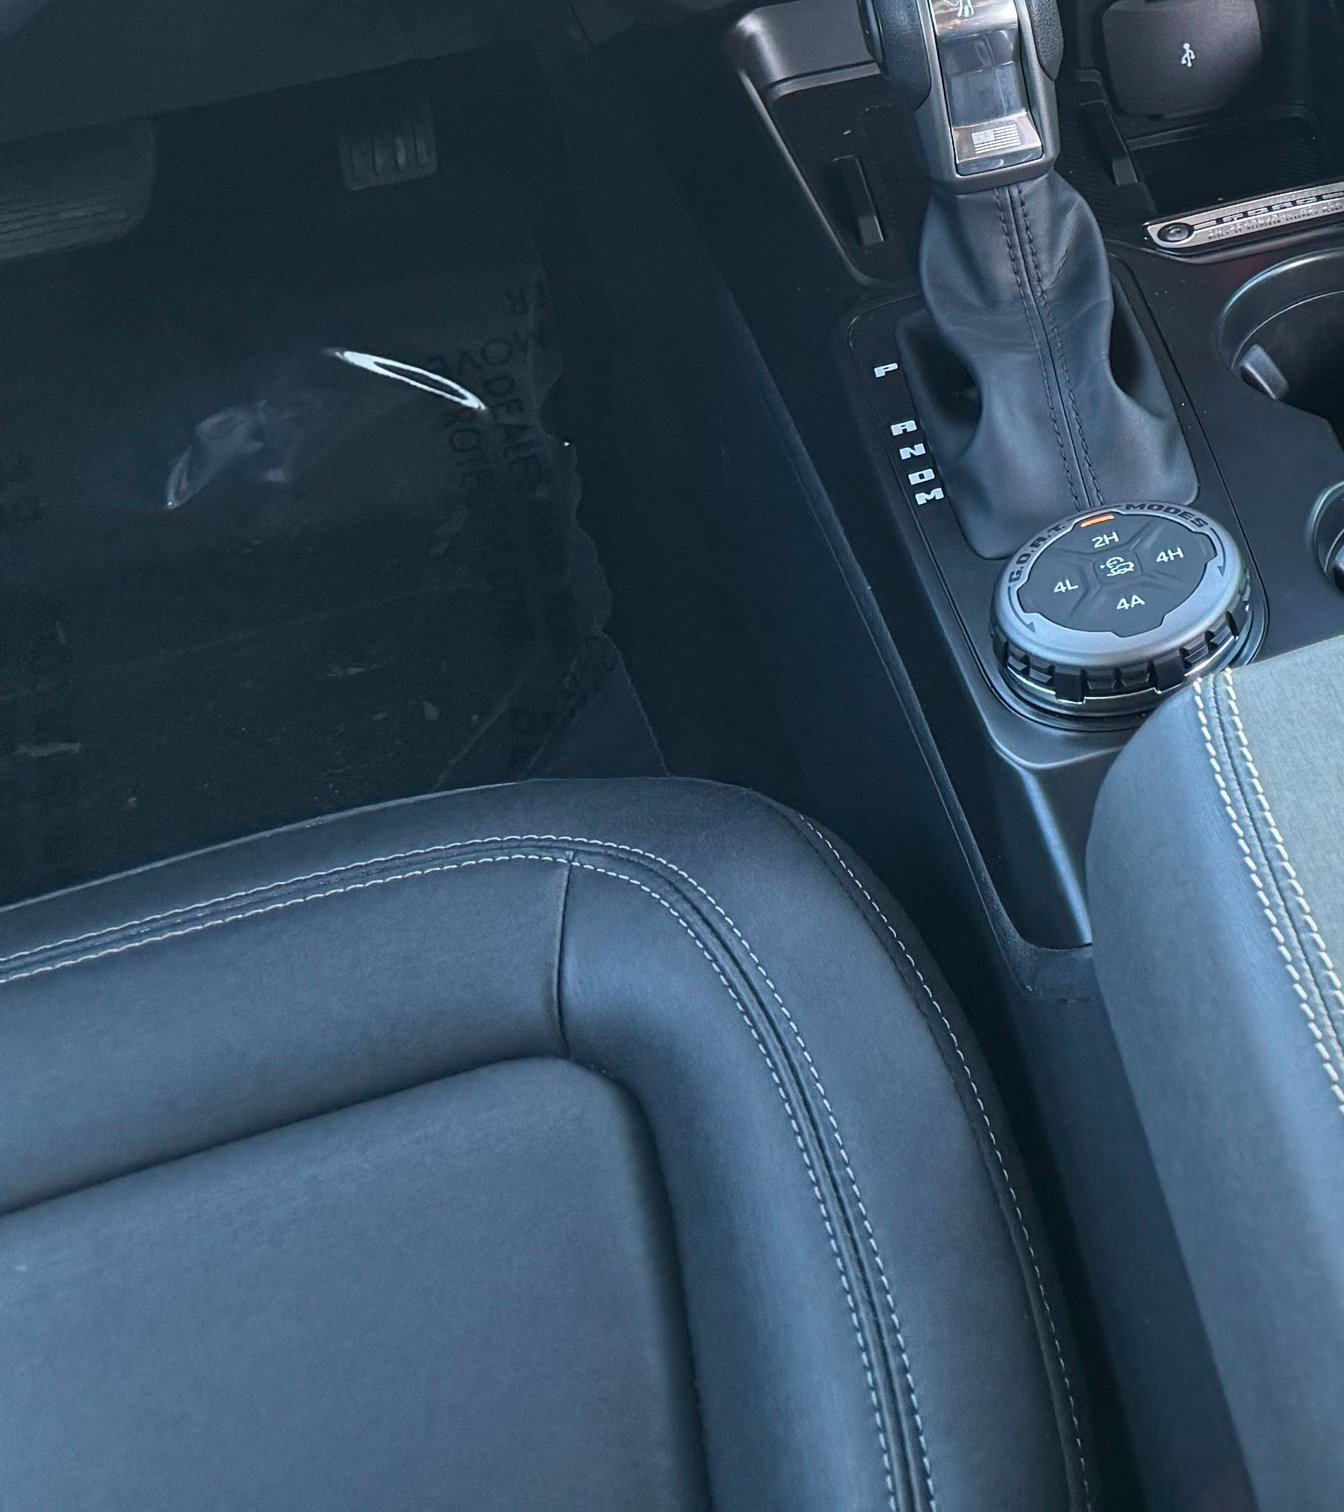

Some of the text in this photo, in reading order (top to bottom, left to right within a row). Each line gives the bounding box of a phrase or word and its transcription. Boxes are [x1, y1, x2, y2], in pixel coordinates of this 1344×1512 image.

[874, 363, 898, 378] P
[890, 420, 917, 436] R
[899, 443, 926, 459] N
[908, 468, 935, 486] D
[915, 487, 944, 505] M
[1125, 502, 1209, 529] MODES
[1092, 532, 1119, 548] 2H
[1008, 521, 1067, 584] G.O.A.T.
[1156, 547, 1184, 563] 4H
[1054, 579, 1078, 593] 4L
[1116, 594, 1145, 610] 4A
